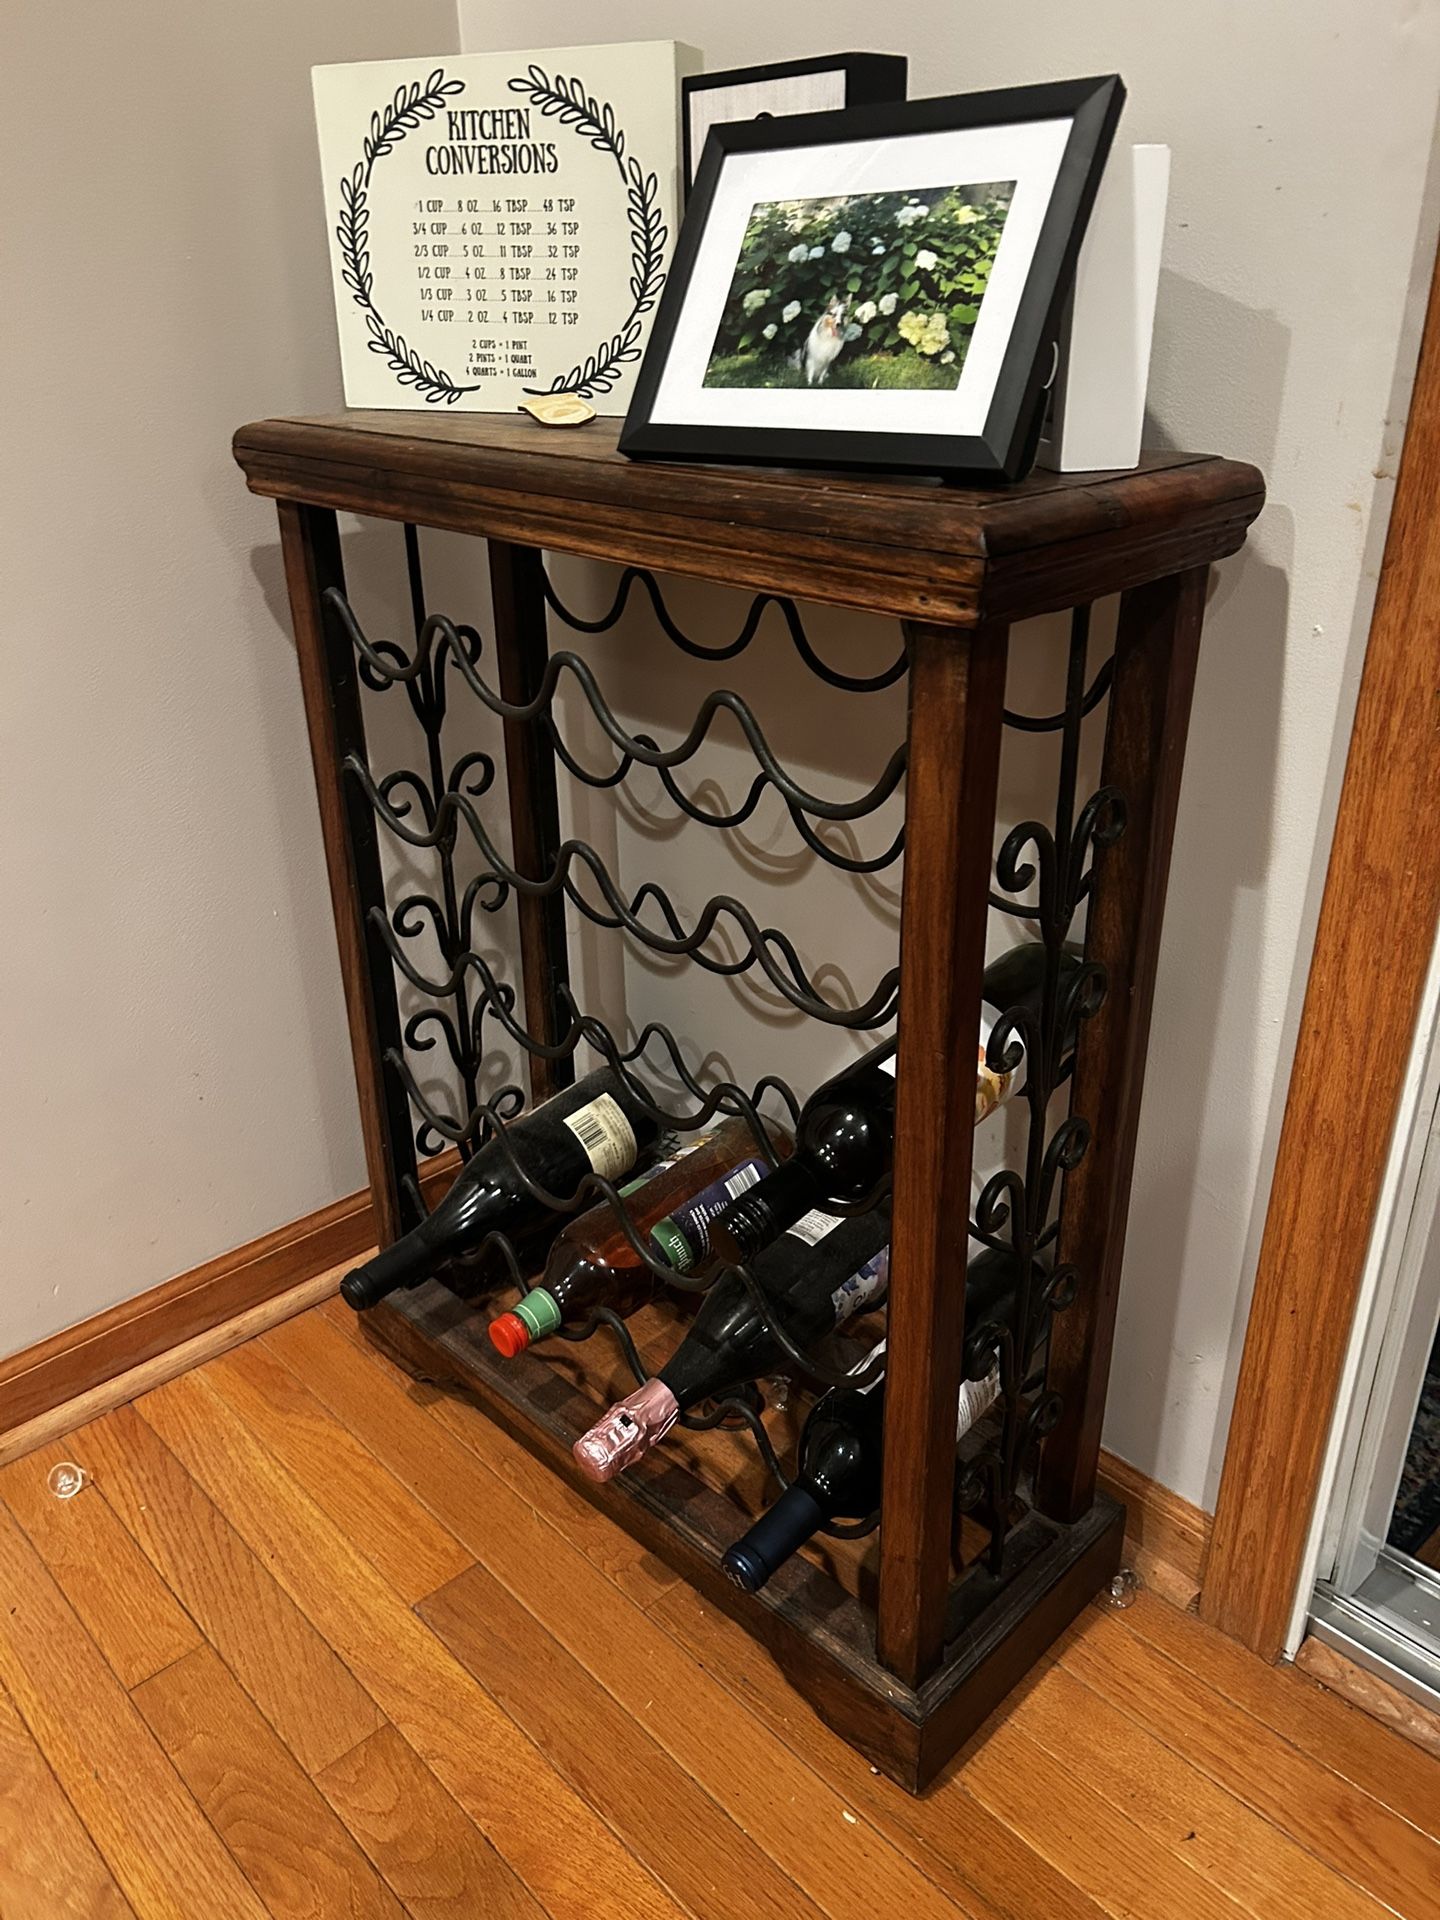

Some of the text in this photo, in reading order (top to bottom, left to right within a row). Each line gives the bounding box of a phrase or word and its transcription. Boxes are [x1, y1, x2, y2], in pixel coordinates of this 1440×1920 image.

[447, 108, 530, 141] KITCHEN
[426, 143, 558, 175] CONVERSIONS
[418, 199, 576, 213] 1 CUP 8 OZ 16 TBSP 48 TSP
[413, 222, 580, 236] 3/4 CUP 6 OZ 12 TBSP 36 TSP
[415, 245, 580, 258] 2/3 CUP 5 OZ 11 TBSP 32 TSP
[418, 267, 579, 281] 1/2 CUP 4 OZ 8 TBSP 24 TSP
[421, 288, 578, 303] 1/3 CUP 3 OZ 5 TBSP 16 TSP
[422, 310, 579, 325] 1/4 CUP 2 OZ 4 TBSP 12 TSP
[472, 340, 477, 349] 2
[480, 340, 497, 349] CUPS
[505, 341, 509, 350] 1
[512, 341, 528, 350] PINT
[468, 353, 474, 363] 2
[477, 353, 496, 363] PINTS
[505, 355, 509, 364] 1
[511, 355, 532, 365] QUART
[465, 367, 470, 376] 4
[473, 367, 498, 377] QUARTS
[506, 368, 510, 377] 1
[513, 368, 537, 378] GALLON
